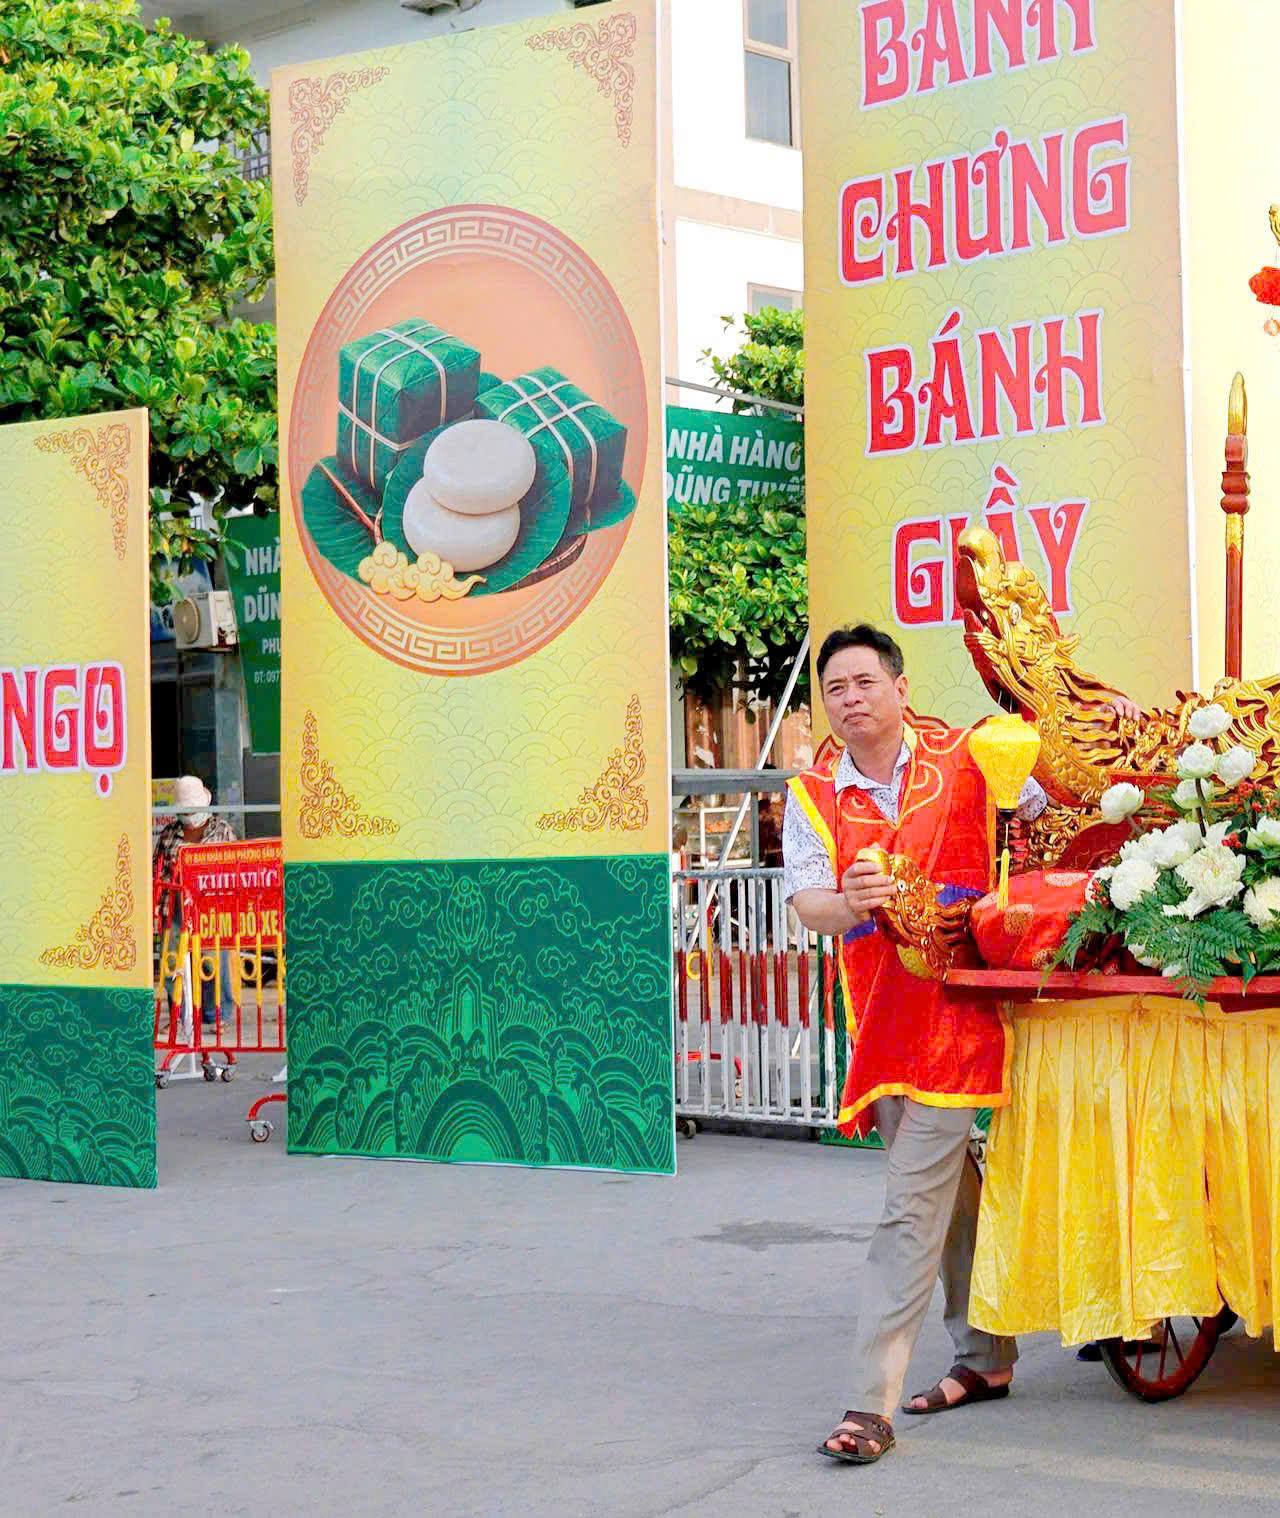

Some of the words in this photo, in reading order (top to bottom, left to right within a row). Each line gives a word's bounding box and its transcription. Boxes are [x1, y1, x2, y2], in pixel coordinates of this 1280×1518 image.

[841, 118, 1128, 283] CHƯNG
[667, 425, 724, 463] NHÀ
[867, 311, 1102, 454] BÁNH
[244, 585, 281, 624] DŨN
[2, 666, 124, 793] NGỌ
